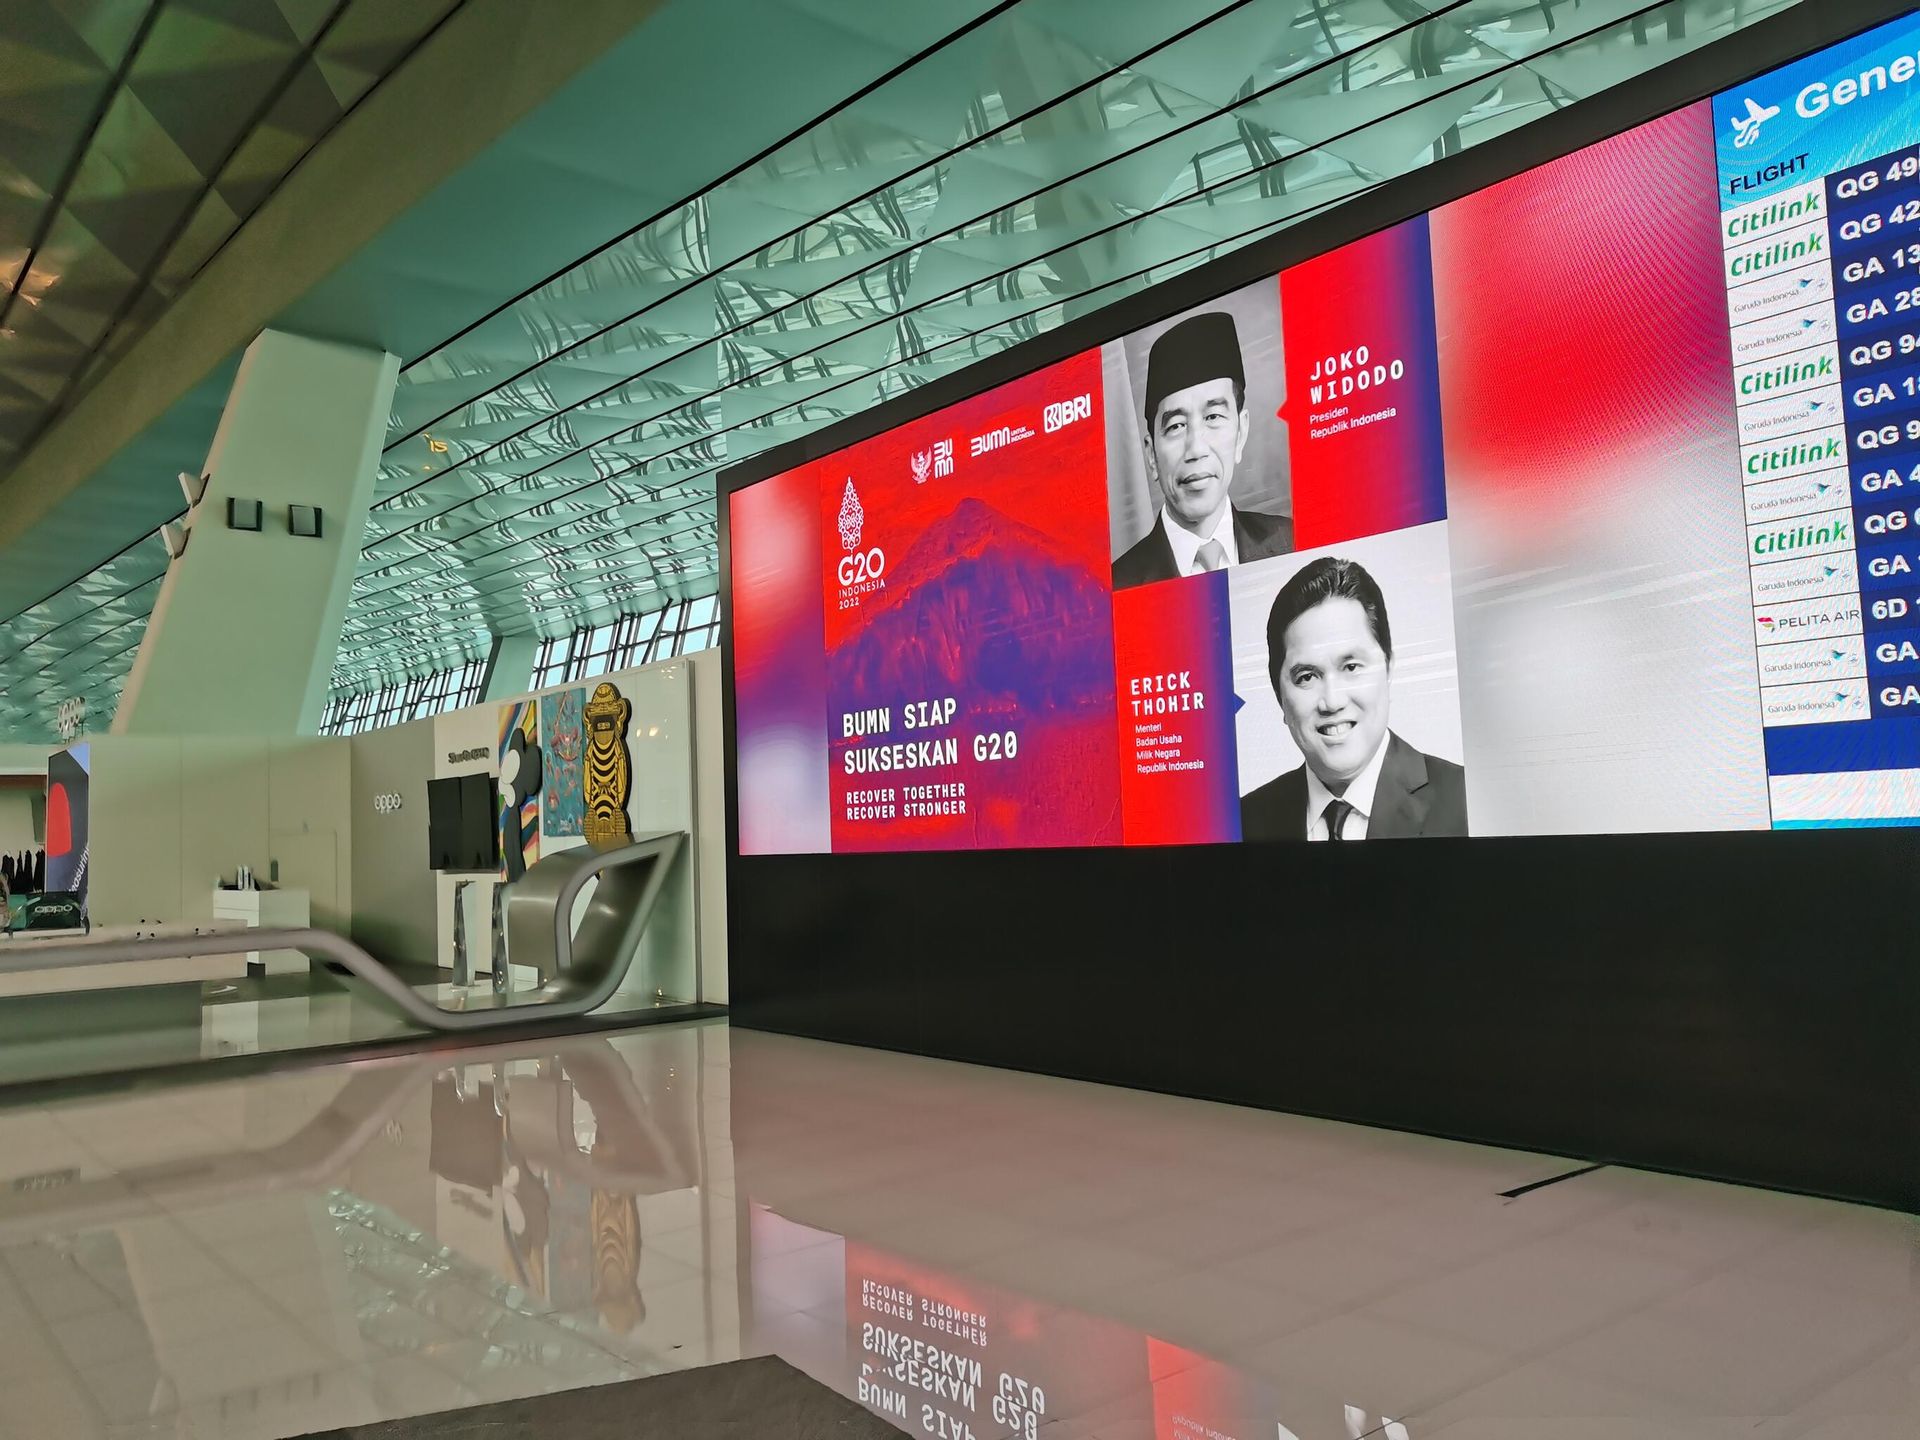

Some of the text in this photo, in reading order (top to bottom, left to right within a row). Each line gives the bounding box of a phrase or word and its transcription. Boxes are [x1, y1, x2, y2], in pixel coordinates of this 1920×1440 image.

[1795, 50, 1920, 118] Gene
[1730, 153, 1809, 194] FLIGHT
[1836, 156, 1920, 199] QG 49
[1728, 191, 1821, 237] Citilink
[1840, 213, 1882, 240] QG
[1731, 232, 1824, 277] Citilink
[1843, 257, 1886, 282] GA
[1734, 289, 1799, 313] Garuda Indonesia
[1846, 298, 1889, 323] GA
[1737, 329, 1802, 352] Garuda Indonesia
[1310, 345, 1369, 381] JOKO
[1849, 340, 1892, 366] QG
[1310, 359, 1404, 405] WIDODO
[1741, 355, 1833, 394] Citilink
[1853, 376, 1920, 407] GA 1
[1062, 393, 1092, 426] BRI
[1309, 406, 1349, 424] Presiden
[1744, 411, 1810, 432] Garuda Indonesia
[1310, 407, 1397, 439] Republik Indonesia
[1857, 425, 1899, 449] QG
[1747, 438, 1841, 474] Citilink
[1861, 469, 1903, 492] GA
[1751, 494, 1817, 511] Garuda Indonesia
[1864, 511, 1907, 534] QG
[1754, 521, 1848, 555] Citilink
[838, 547, 885, 586] G20
[1868, 554, 1911, 577] GA
[839, 578, 886, 598] INDONESIA
[1758, 576, 1824, 592] Garuda Indonesia
[839, 597, 860, 610] 2022
[1872, 598, 1907, 620] 6D
[1779, 610, 1861, 628] PELITA AIR
[1876, 641, 1920, 663] GA
[1764, 659, 1832, 673] Garuda Indonesia
[1131, 671, 1190, 695] ERICK
[1131, 692, 1204, 717] THOHIR
[1880, 685, 1920, 707] GA
[843, 697, 957, 738] BUMN SIAP
[1768, 705, 1797, 713] Garuda
[1135, 722, 1162, 733] Menteri
[844, 731, 1018, 775] SUKSESKAN G20
[1136, 735, 1183, 747] Badan Usaha
[1136, 749, 1181, 760] Milik Negara
[1137, 759, 1205, 774] Republik Indonesia
[846, 783, 966, 805] RECOVER TOGETHER
[847, 800, 966, 821] RECOVER STRONGER
